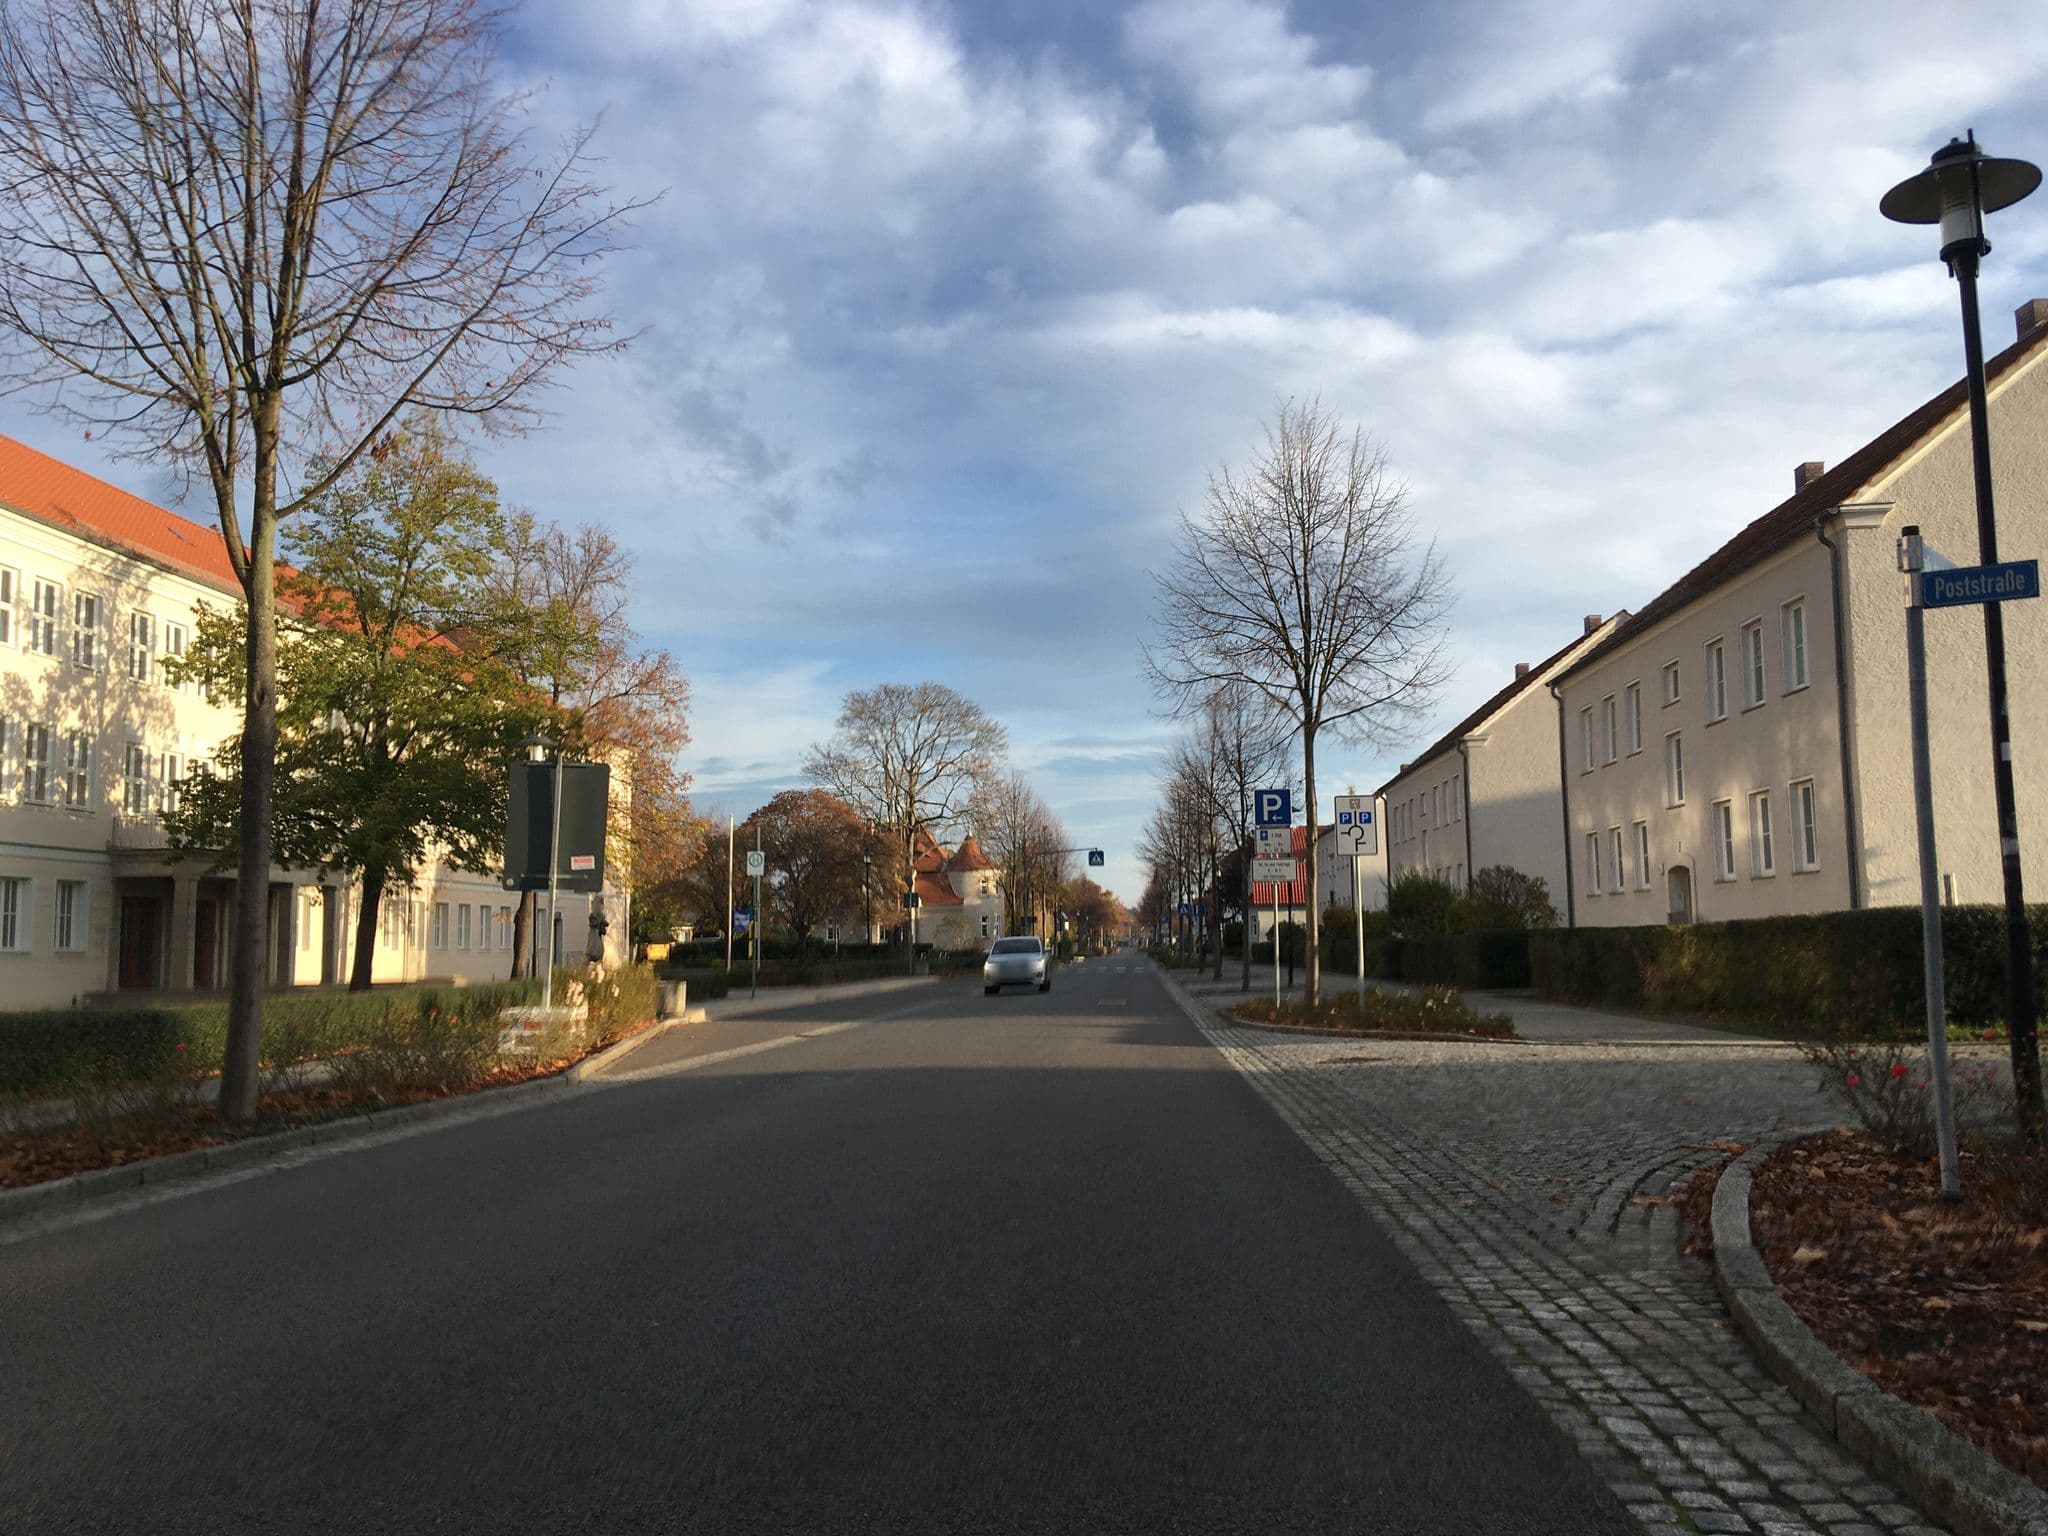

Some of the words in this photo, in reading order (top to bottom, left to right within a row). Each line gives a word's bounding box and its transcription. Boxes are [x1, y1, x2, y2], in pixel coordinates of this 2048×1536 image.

[1935, 569, 2026, 600] Poststraße
[1262, 793, 1282, 821] P
[1342, 813, 1349, 823] P
[1361, 813, 1369, 823] P
